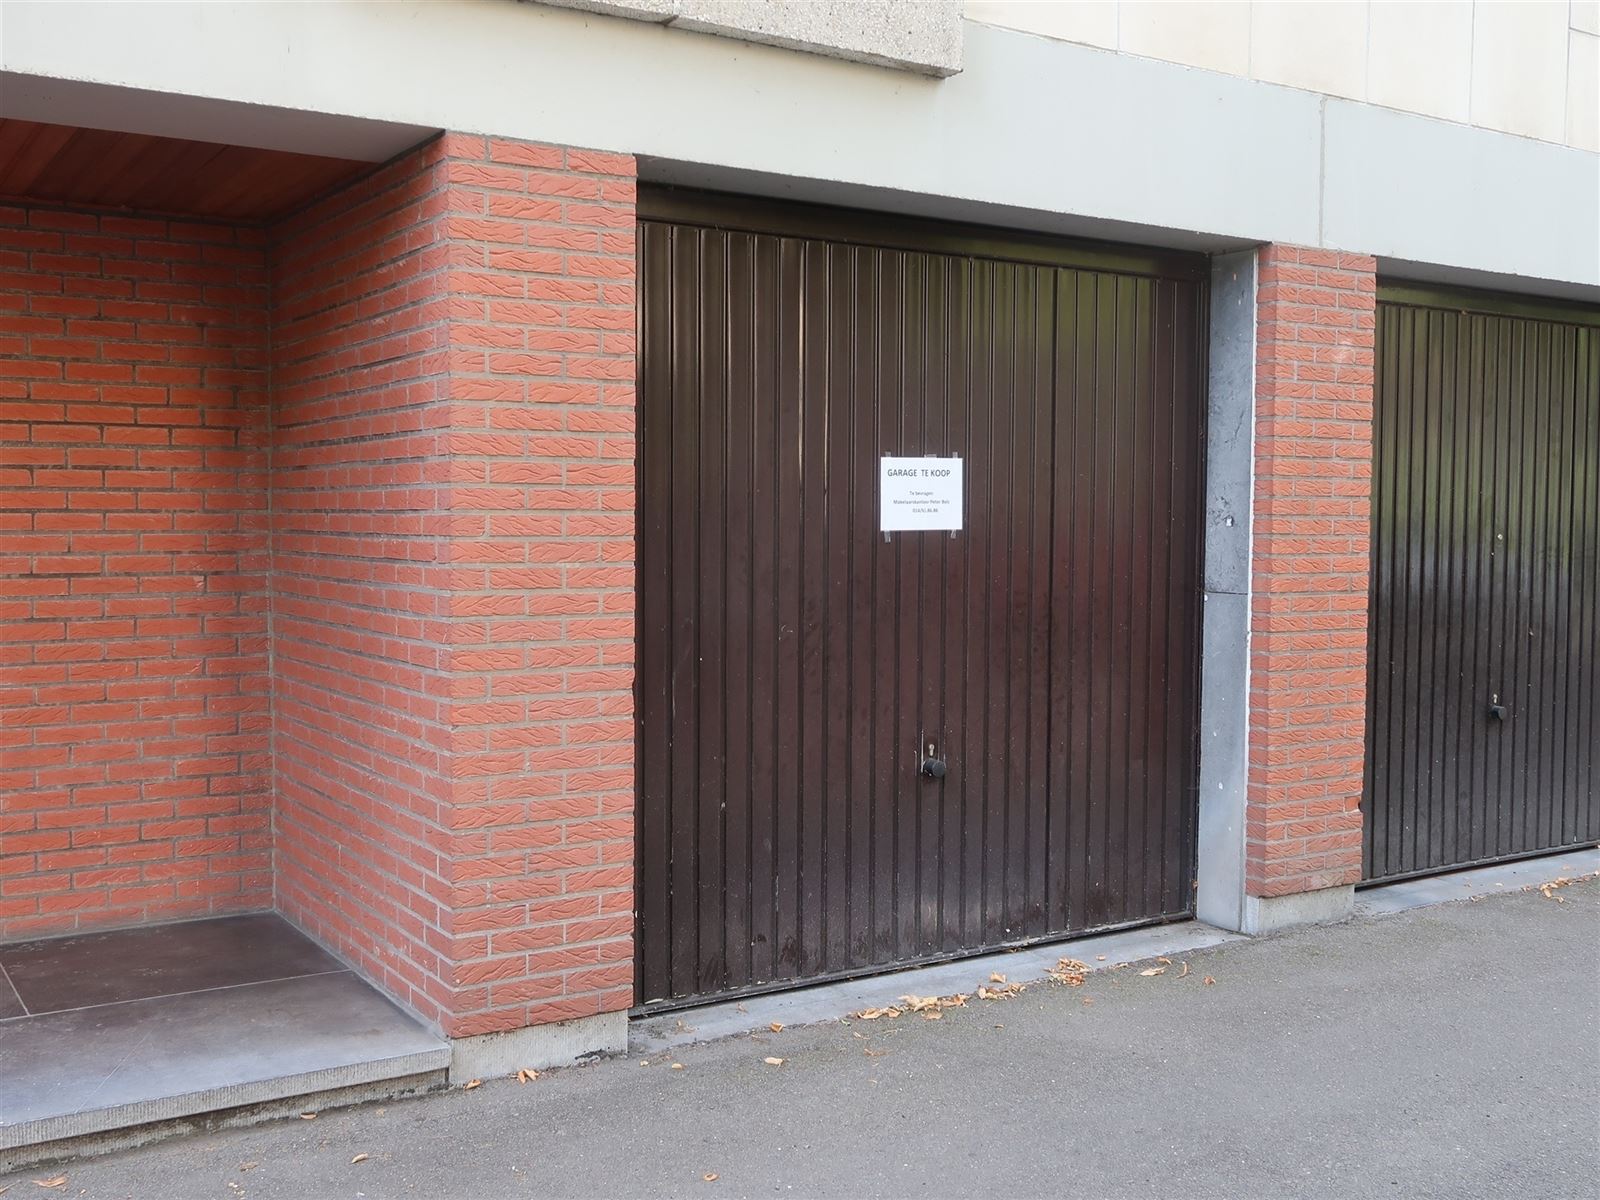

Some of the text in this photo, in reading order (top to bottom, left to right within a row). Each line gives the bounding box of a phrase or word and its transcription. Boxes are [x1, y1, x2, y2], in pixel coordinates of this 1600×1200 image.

[887, 469, 951, 477] GARAGE TE KOOP
